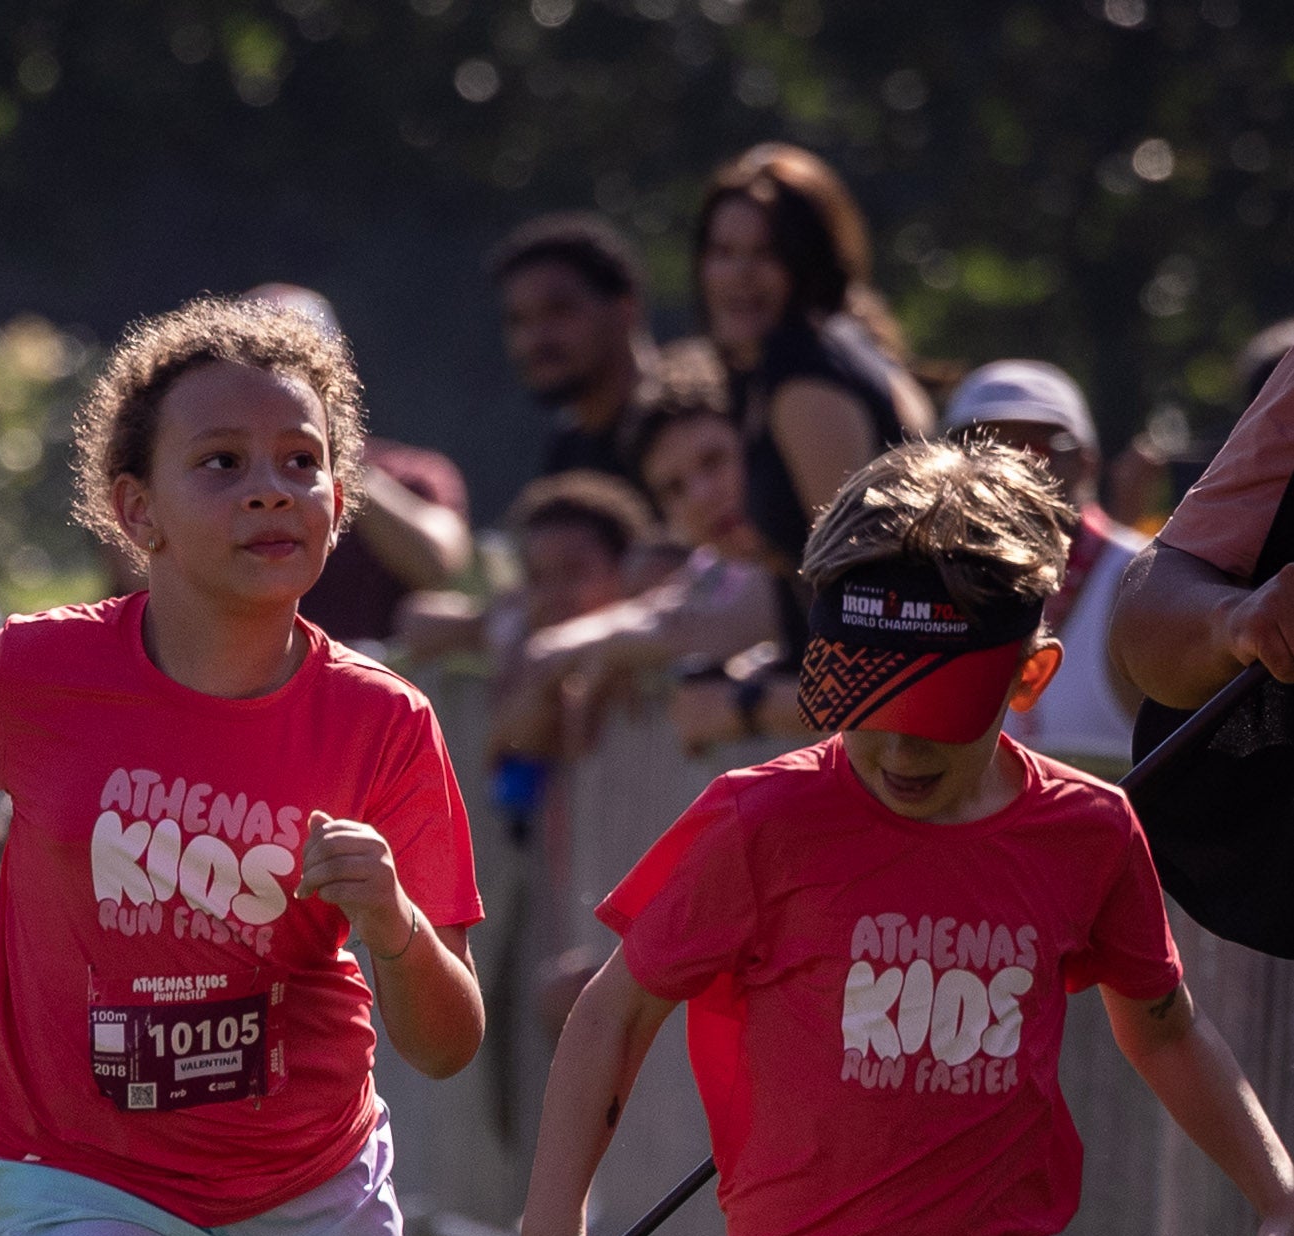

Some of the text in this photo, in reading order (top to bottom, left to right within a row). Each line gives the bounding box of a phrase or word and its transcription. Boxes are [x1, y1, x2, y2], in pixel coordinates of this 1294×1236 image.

[842, 612, 968, 633] WORLD CHAMPIONSHIP
[100, 768, 302, 850] ATHENAS
[91, 810, 295, 925] KIDS
[98, 898, 274, 957] RUN FASTER
[850, 912, 1037, 970] ATHENAS
[133, 974, 228, 992] ATHENAS KIDS
[154, 989, 207, 1002] RUN FASTER
[91, 1011, 127, 1022] 100m
[841, 958, 1034, 1066] KIDS
[148, 1012, 260, 1058] 10105
[94, 1063, 126, 1077] 2018
[180, 1056, 238, 1072] VALENTINA
[841, 1048, 1019, 1095] RUN FASTER
[170, 1089, 187, 1098] rvb
